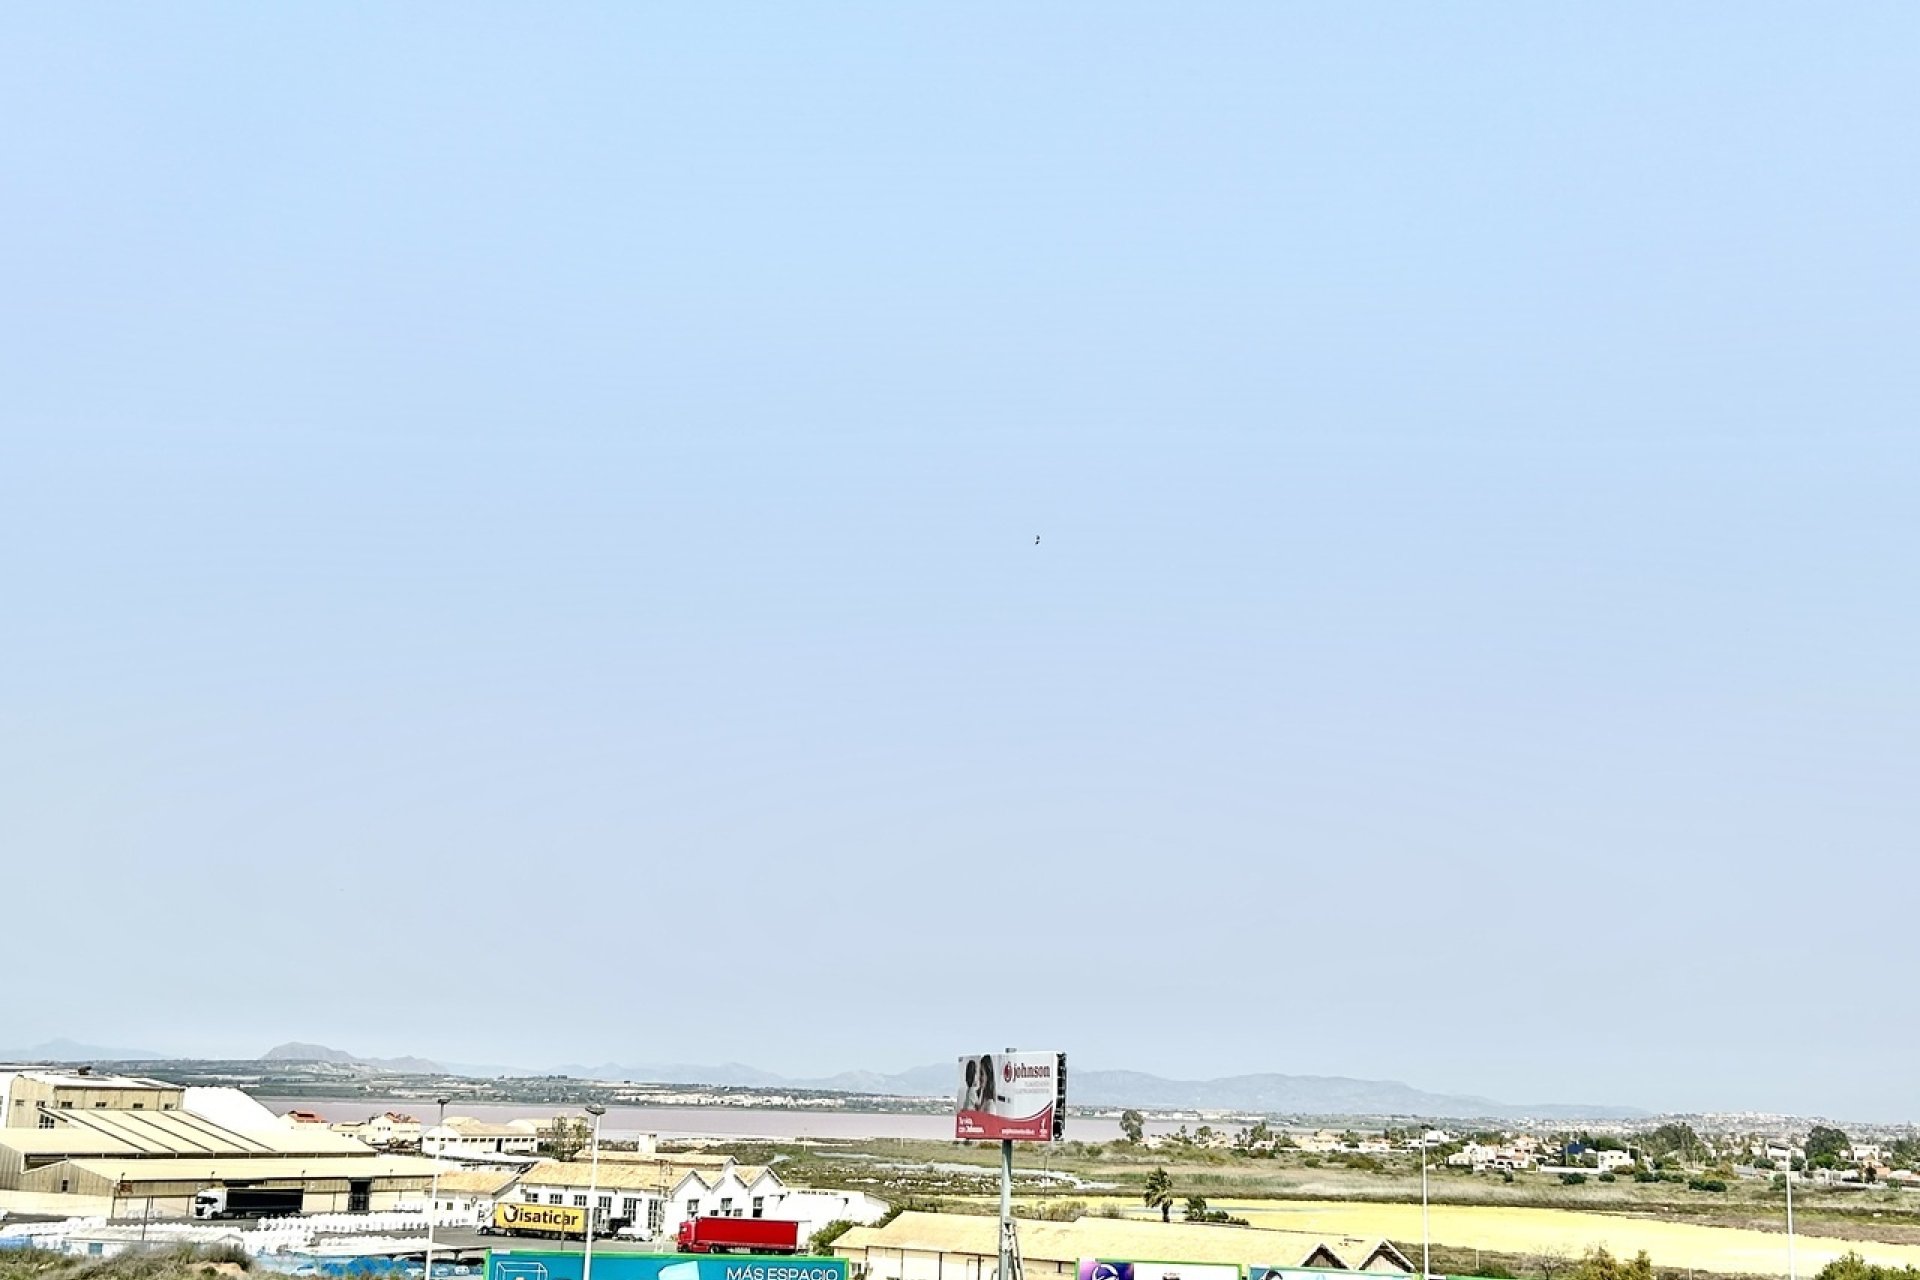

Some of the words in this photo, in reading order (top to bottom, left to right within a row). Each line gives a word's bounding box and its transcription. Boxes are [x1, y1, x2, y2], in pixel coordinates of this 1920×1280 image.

[1013, 1063, 1050, 1082] johnson
[726, 1263, 764, 1280] MÁS
[767, 1268, 838, 1280] ESPACIO
